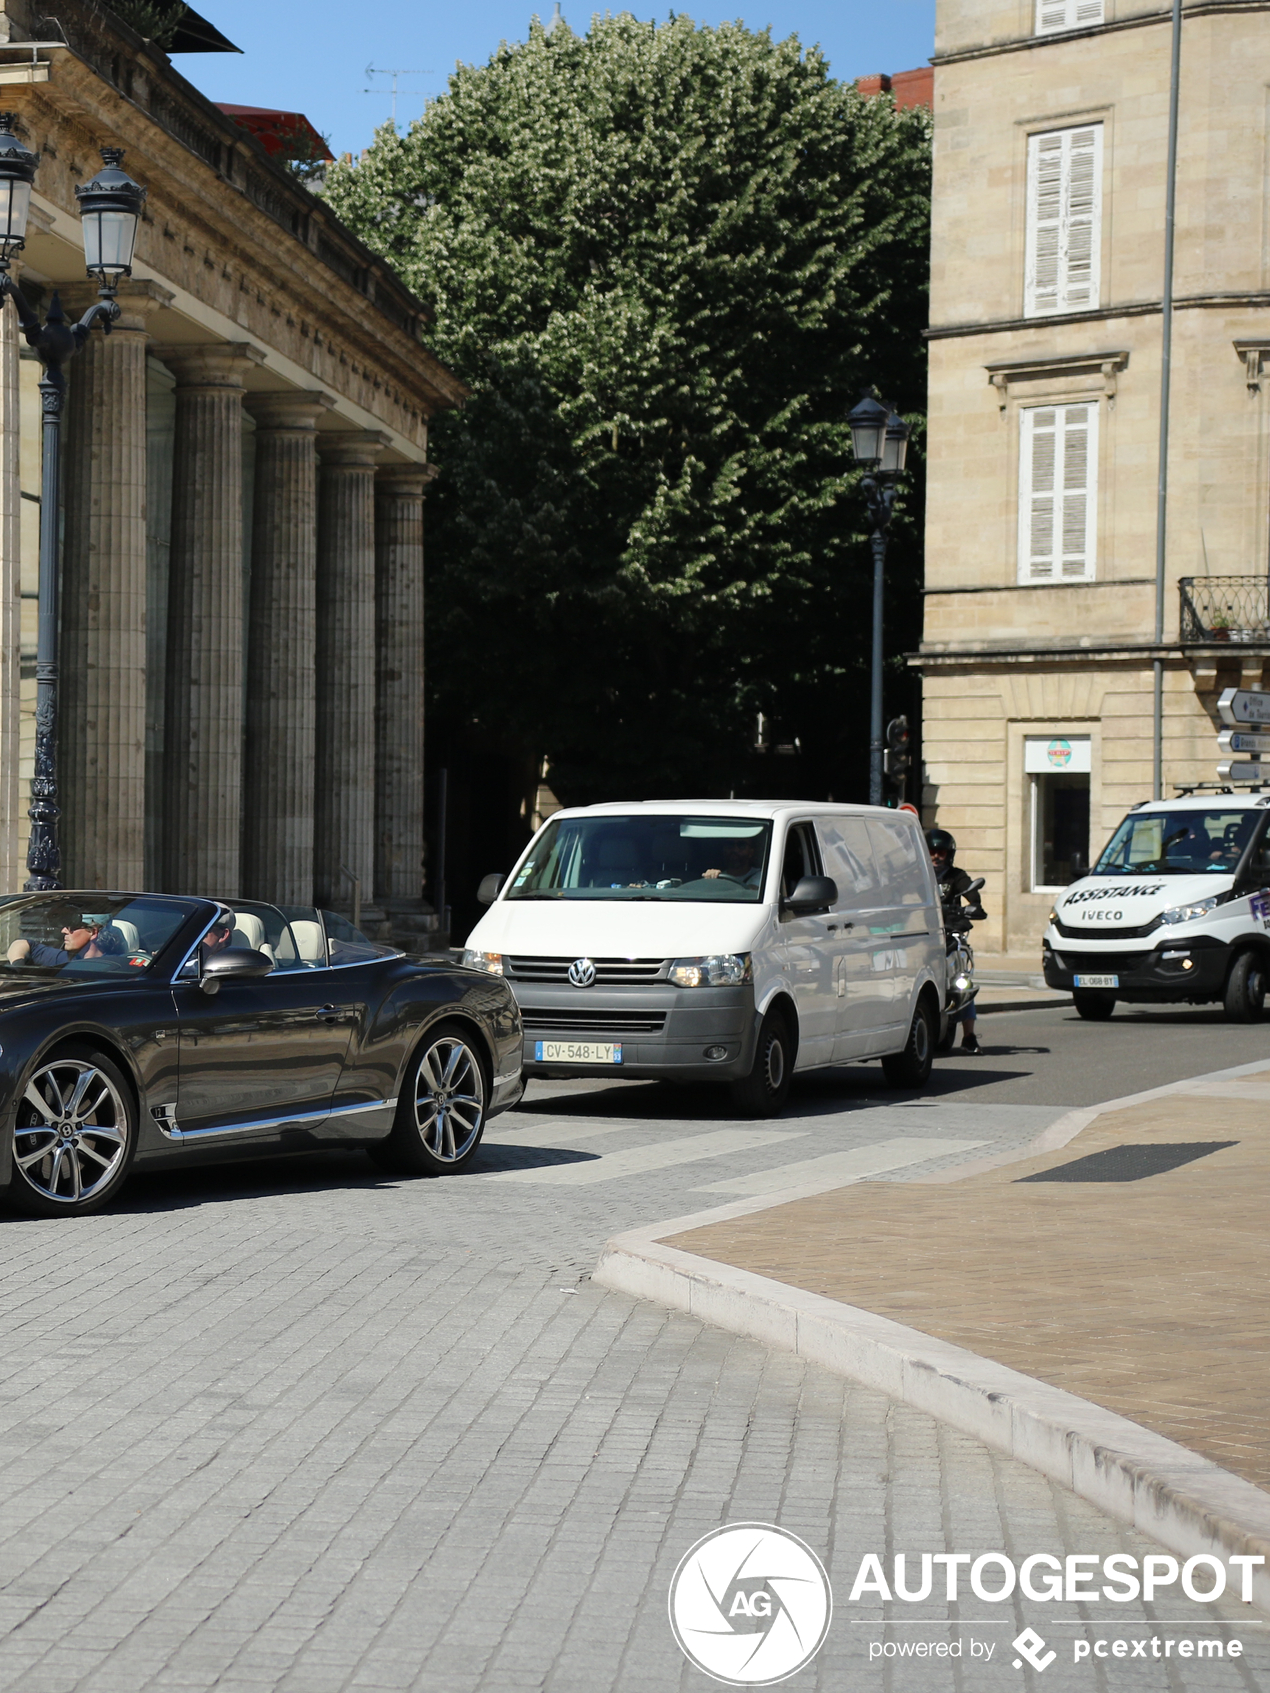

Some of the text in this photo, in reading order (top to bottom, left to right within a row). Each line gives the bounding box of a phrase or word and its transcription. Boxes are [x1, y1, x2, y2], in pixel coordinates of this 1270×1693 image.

[1063, 884, 1167, 908] ASSISTANCE
[1082, 911, 1123, 921] IVECO
[546, 1044, 611, 1060] CV-548-LY
